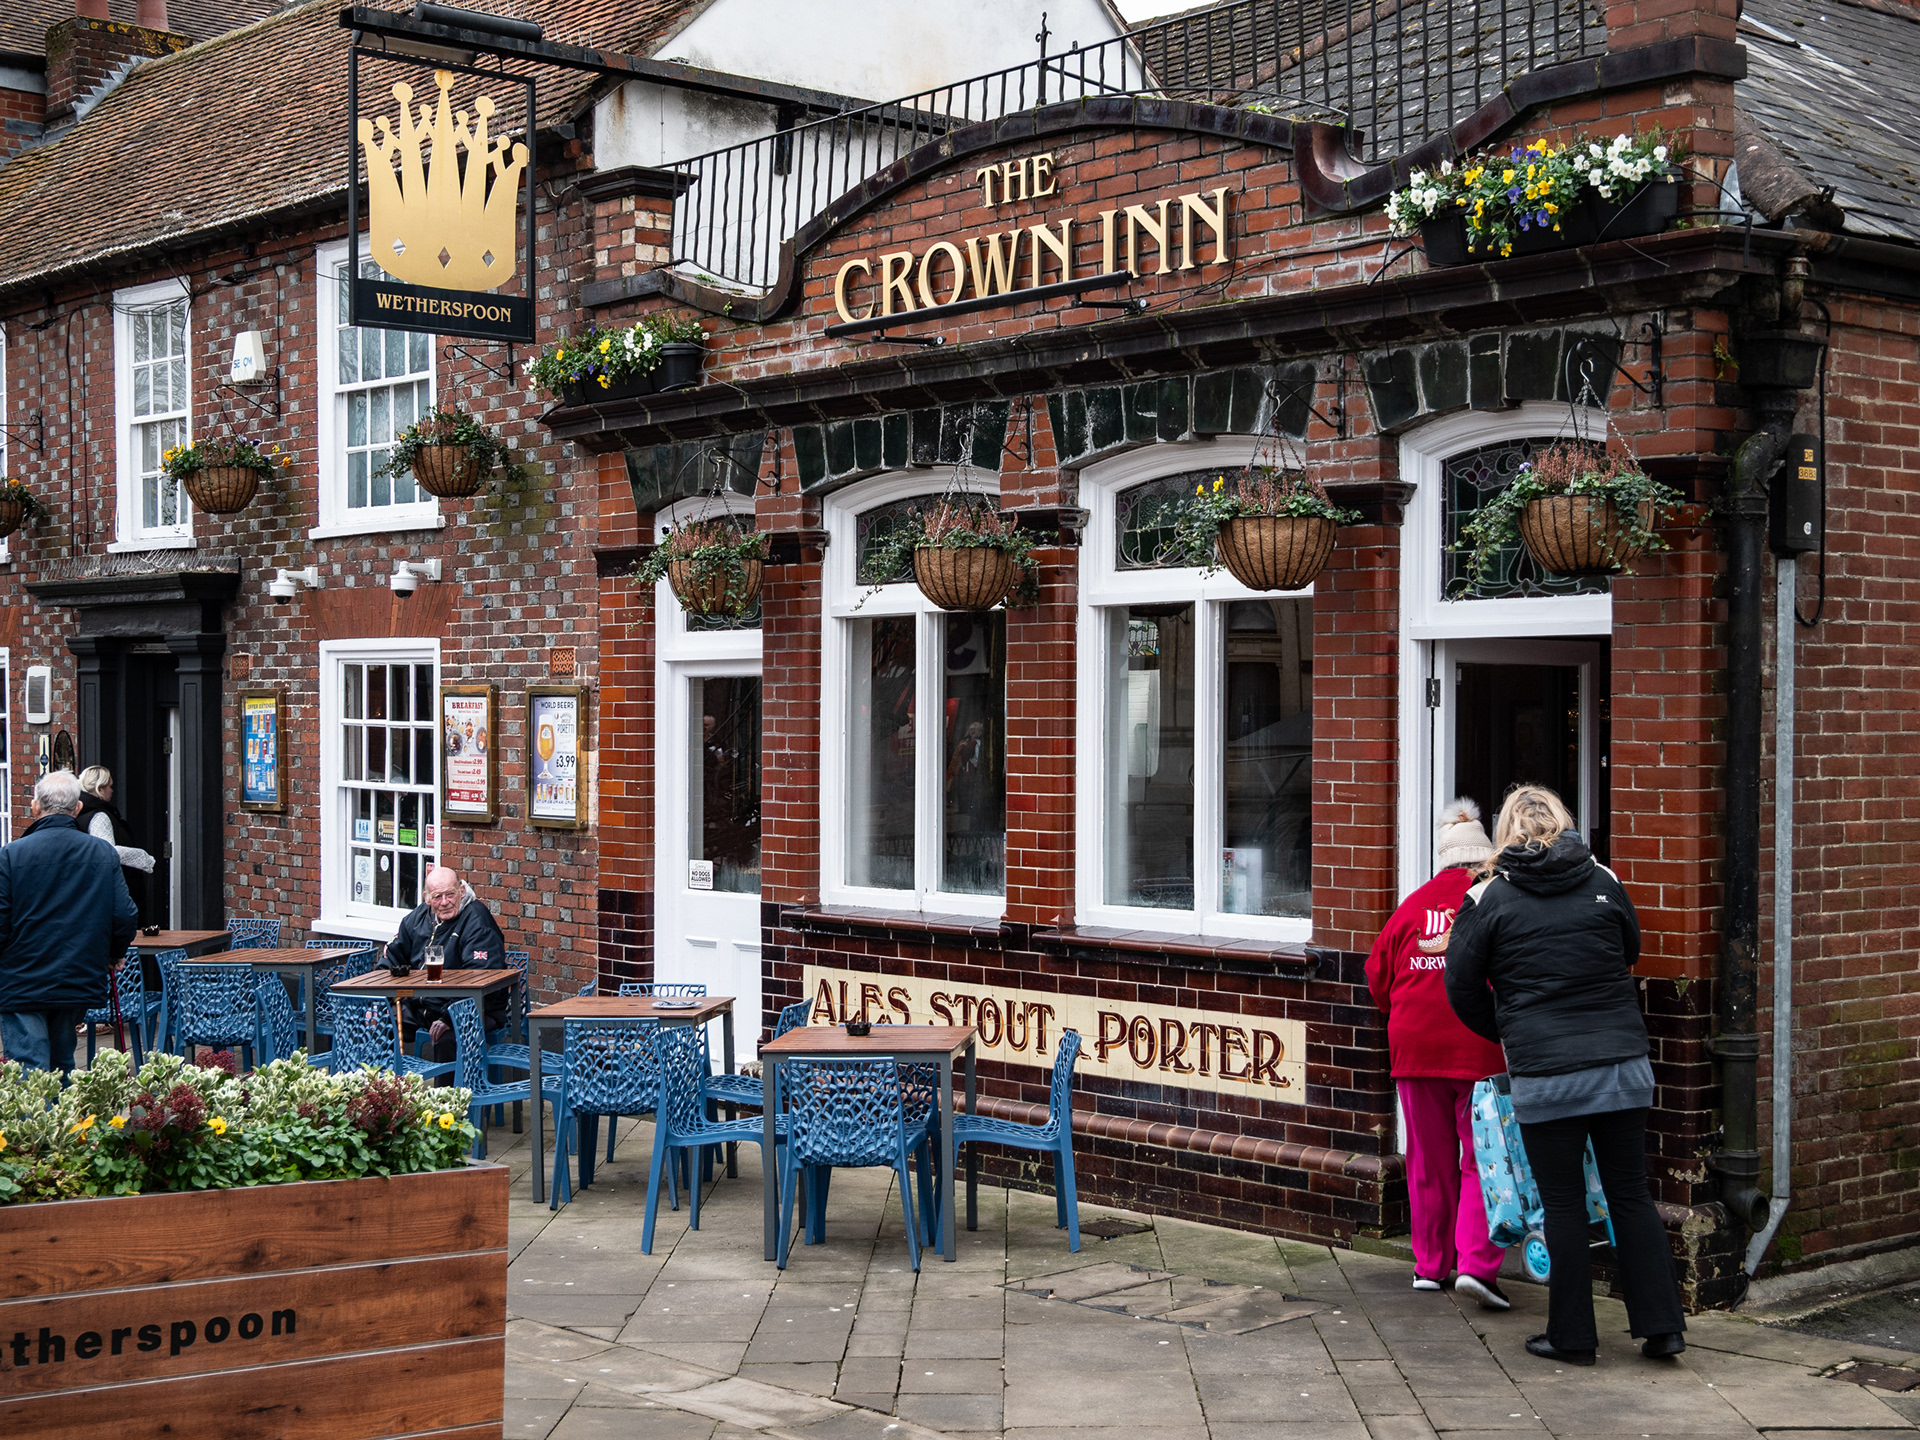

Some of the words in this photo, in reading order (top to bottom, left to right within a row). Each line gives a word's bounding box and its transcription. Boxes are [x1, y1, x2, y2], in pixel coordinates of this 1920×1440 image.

[976, 152, 1058, 208] THE
[834, 217, 1074, 323] CROWN
[1099, 187, 1230, 278] INN
[375, 292, 512, 323] WETHERSPOON
[556, 755, 576, 767] £3.99
[812, 978, 912, 1026] ALES
[928, 991, 1056, 1055] STOUT
[1094, 1010, 1291, 1089] PORTER
[0, 1308, 297, 1367] therspoon
